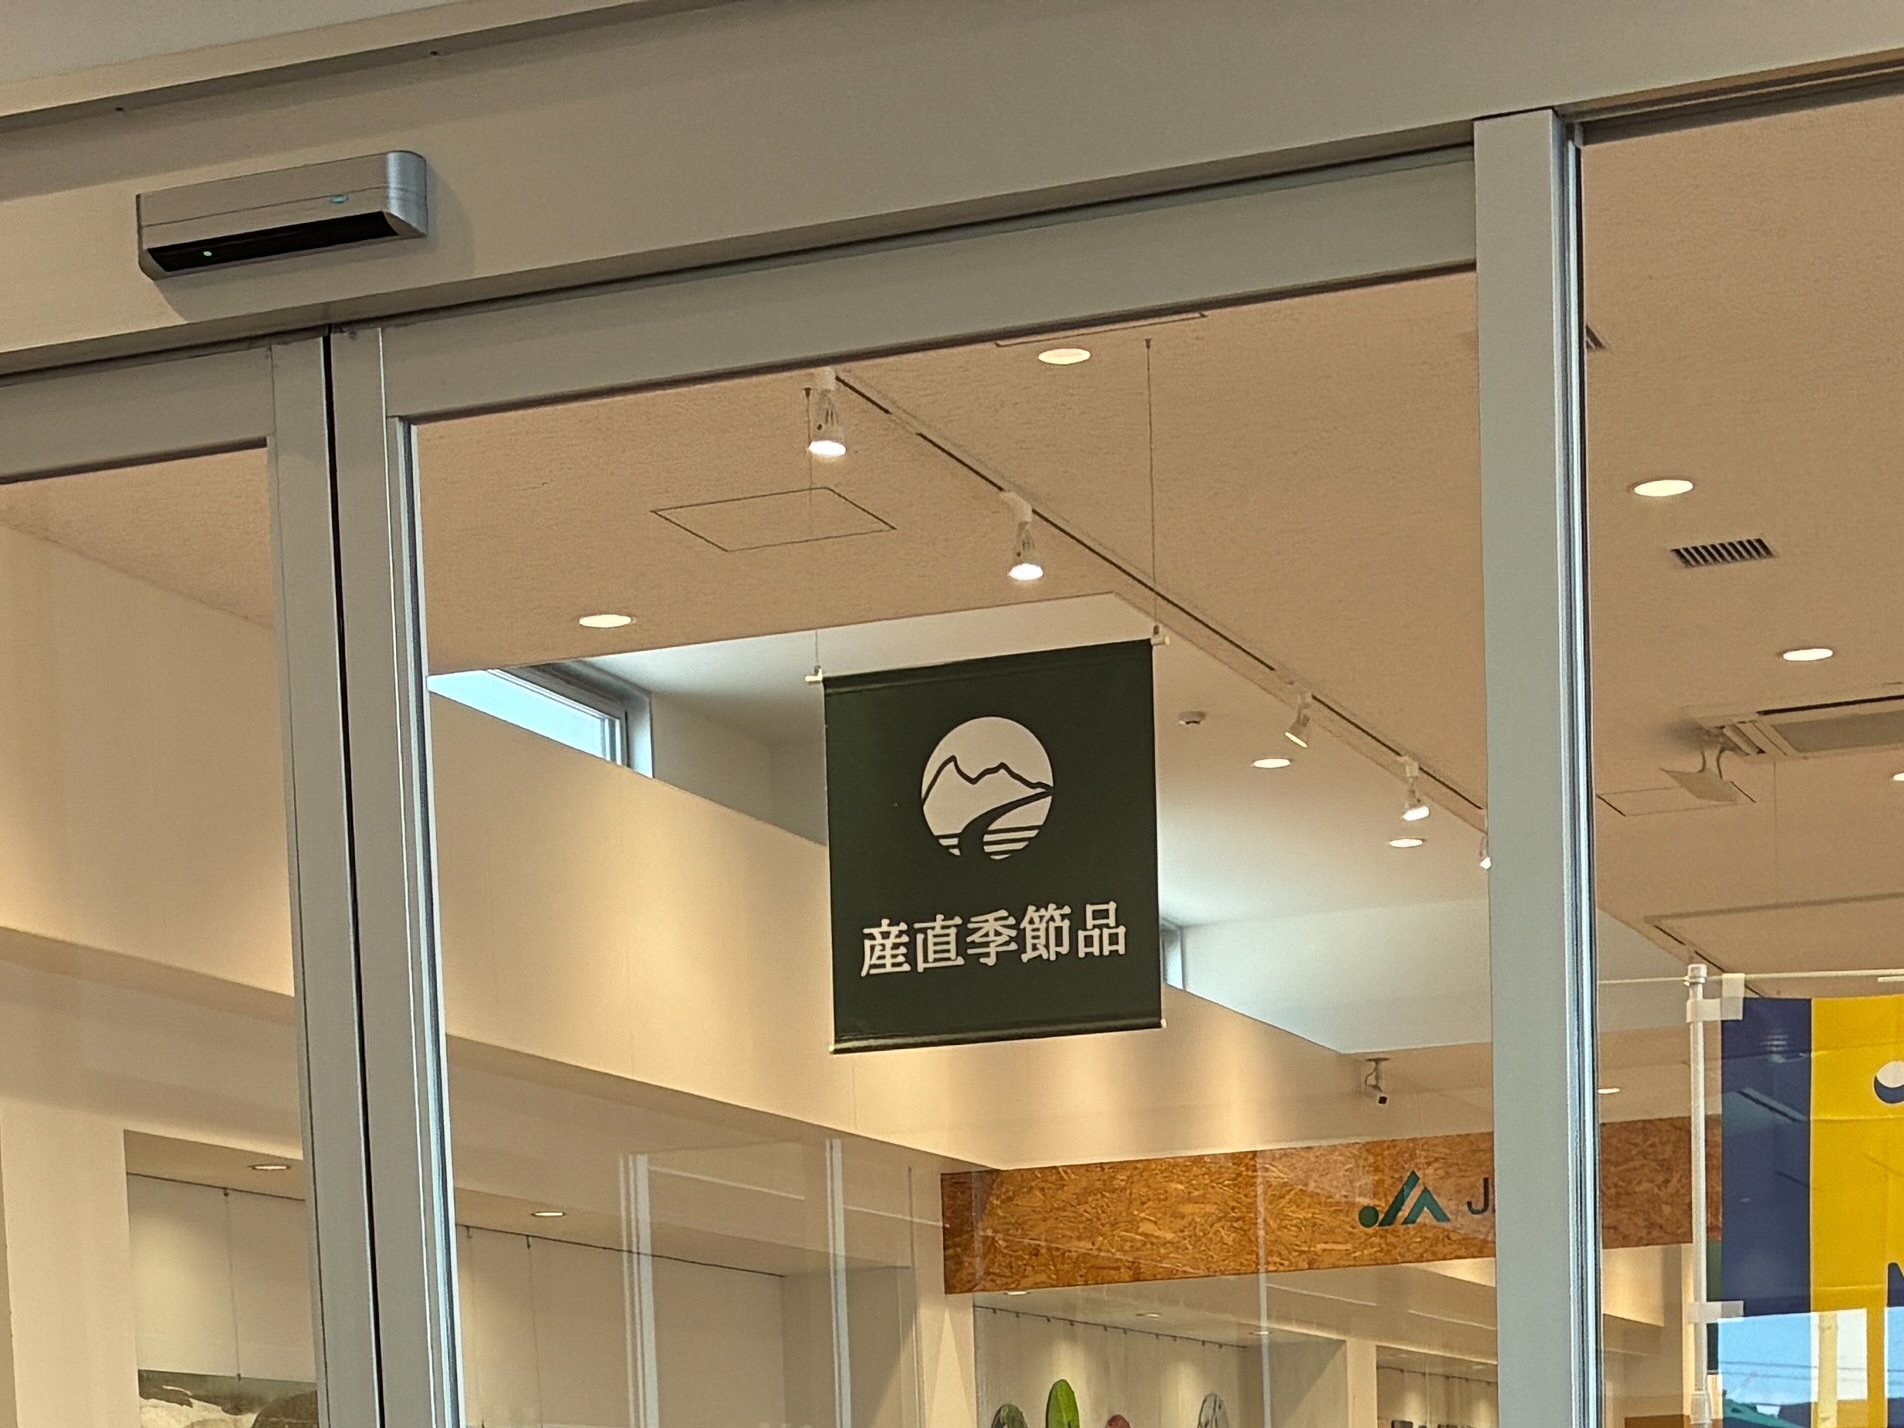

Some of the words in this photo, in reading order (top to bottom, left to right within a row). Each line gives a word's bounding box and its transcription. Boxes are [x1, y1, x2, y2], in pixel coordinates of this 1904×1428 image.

[861, 901, 1126, 977] 産直季節品
[1467, 1177, 1490, 1215] J
